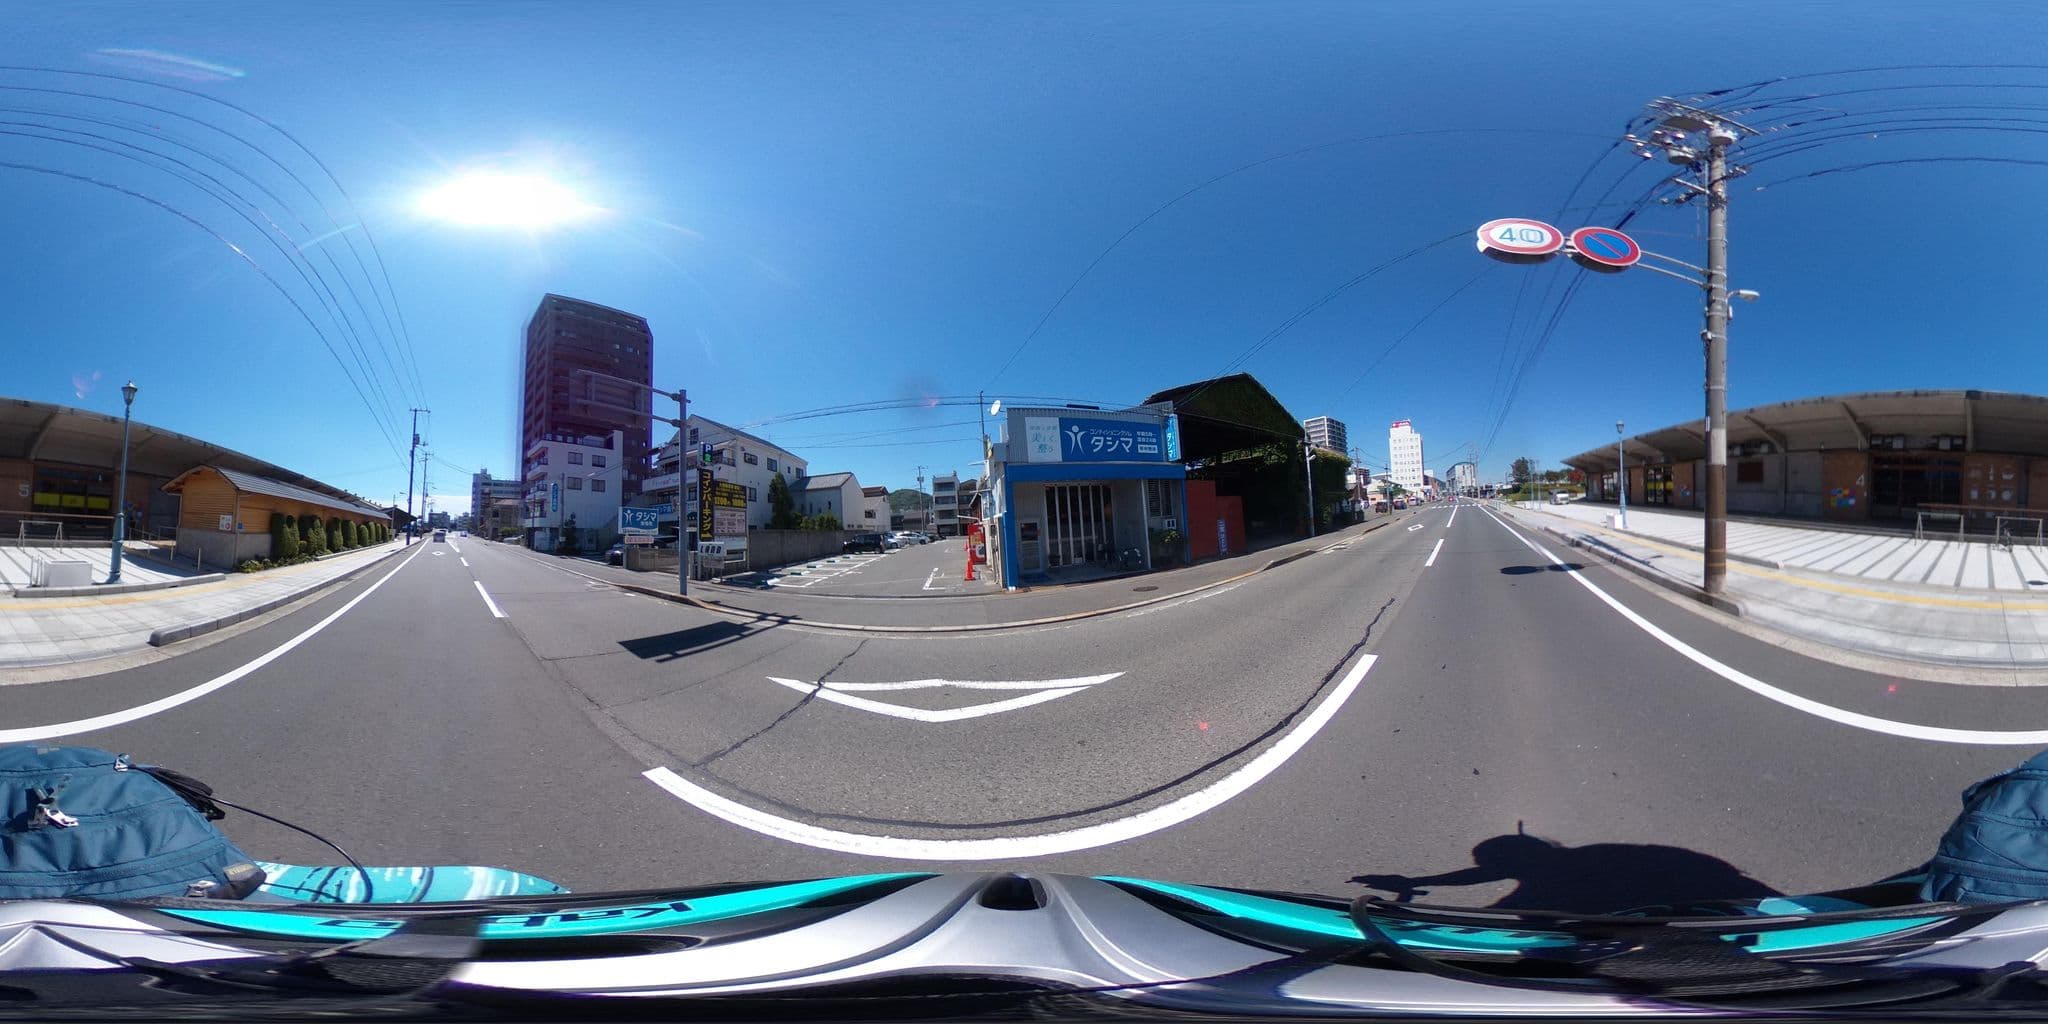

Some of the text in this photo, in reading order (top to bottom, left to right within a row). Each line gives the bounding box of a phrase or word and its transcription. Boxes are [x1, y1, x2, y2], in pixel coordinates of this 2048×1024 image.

[1499, 227, 1544, 243] 40
[705, 444, 711, 453] P
[1090, 436, 1133, 453] タシマ
[702, 471, 711, 531] コインパーキング
[636, 511, 657, 522] タシマ
